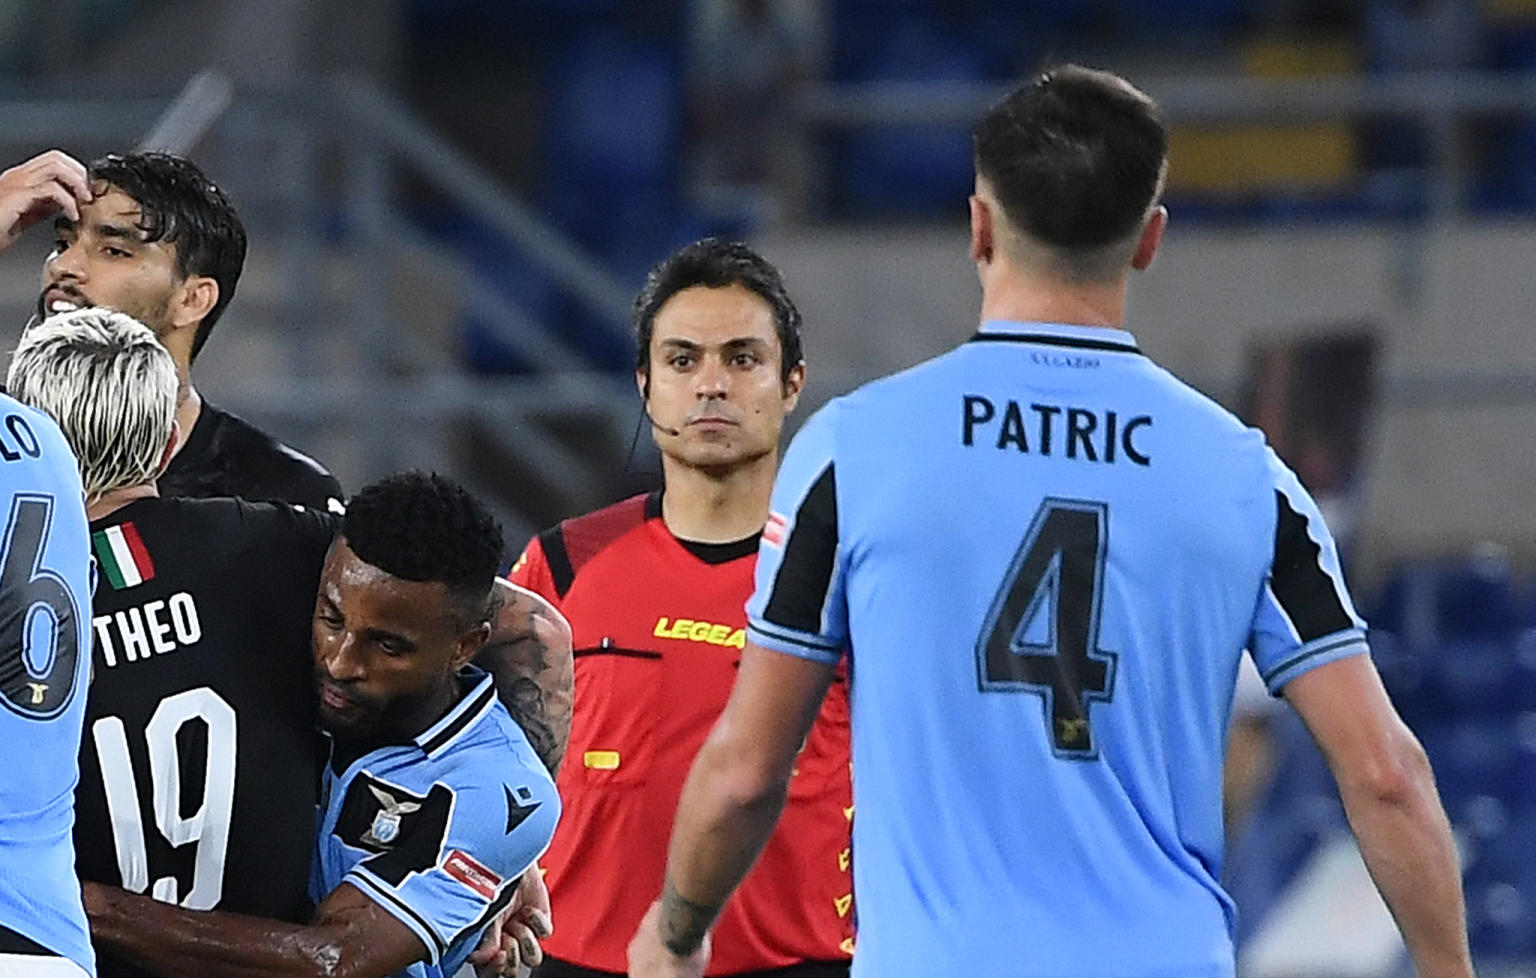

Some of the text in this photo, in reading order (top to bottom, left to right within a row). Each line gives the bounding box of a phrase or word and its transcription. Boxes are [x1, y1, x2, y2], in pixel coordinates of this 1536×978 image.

[962, 394, 1153, 467] PATRIC
[93, 592, 202, 667] THEO
[653, 617, 746, 649] LEGEA
[975, 496, 1117, 761] 4
[92, 687, 237, 913] 19
